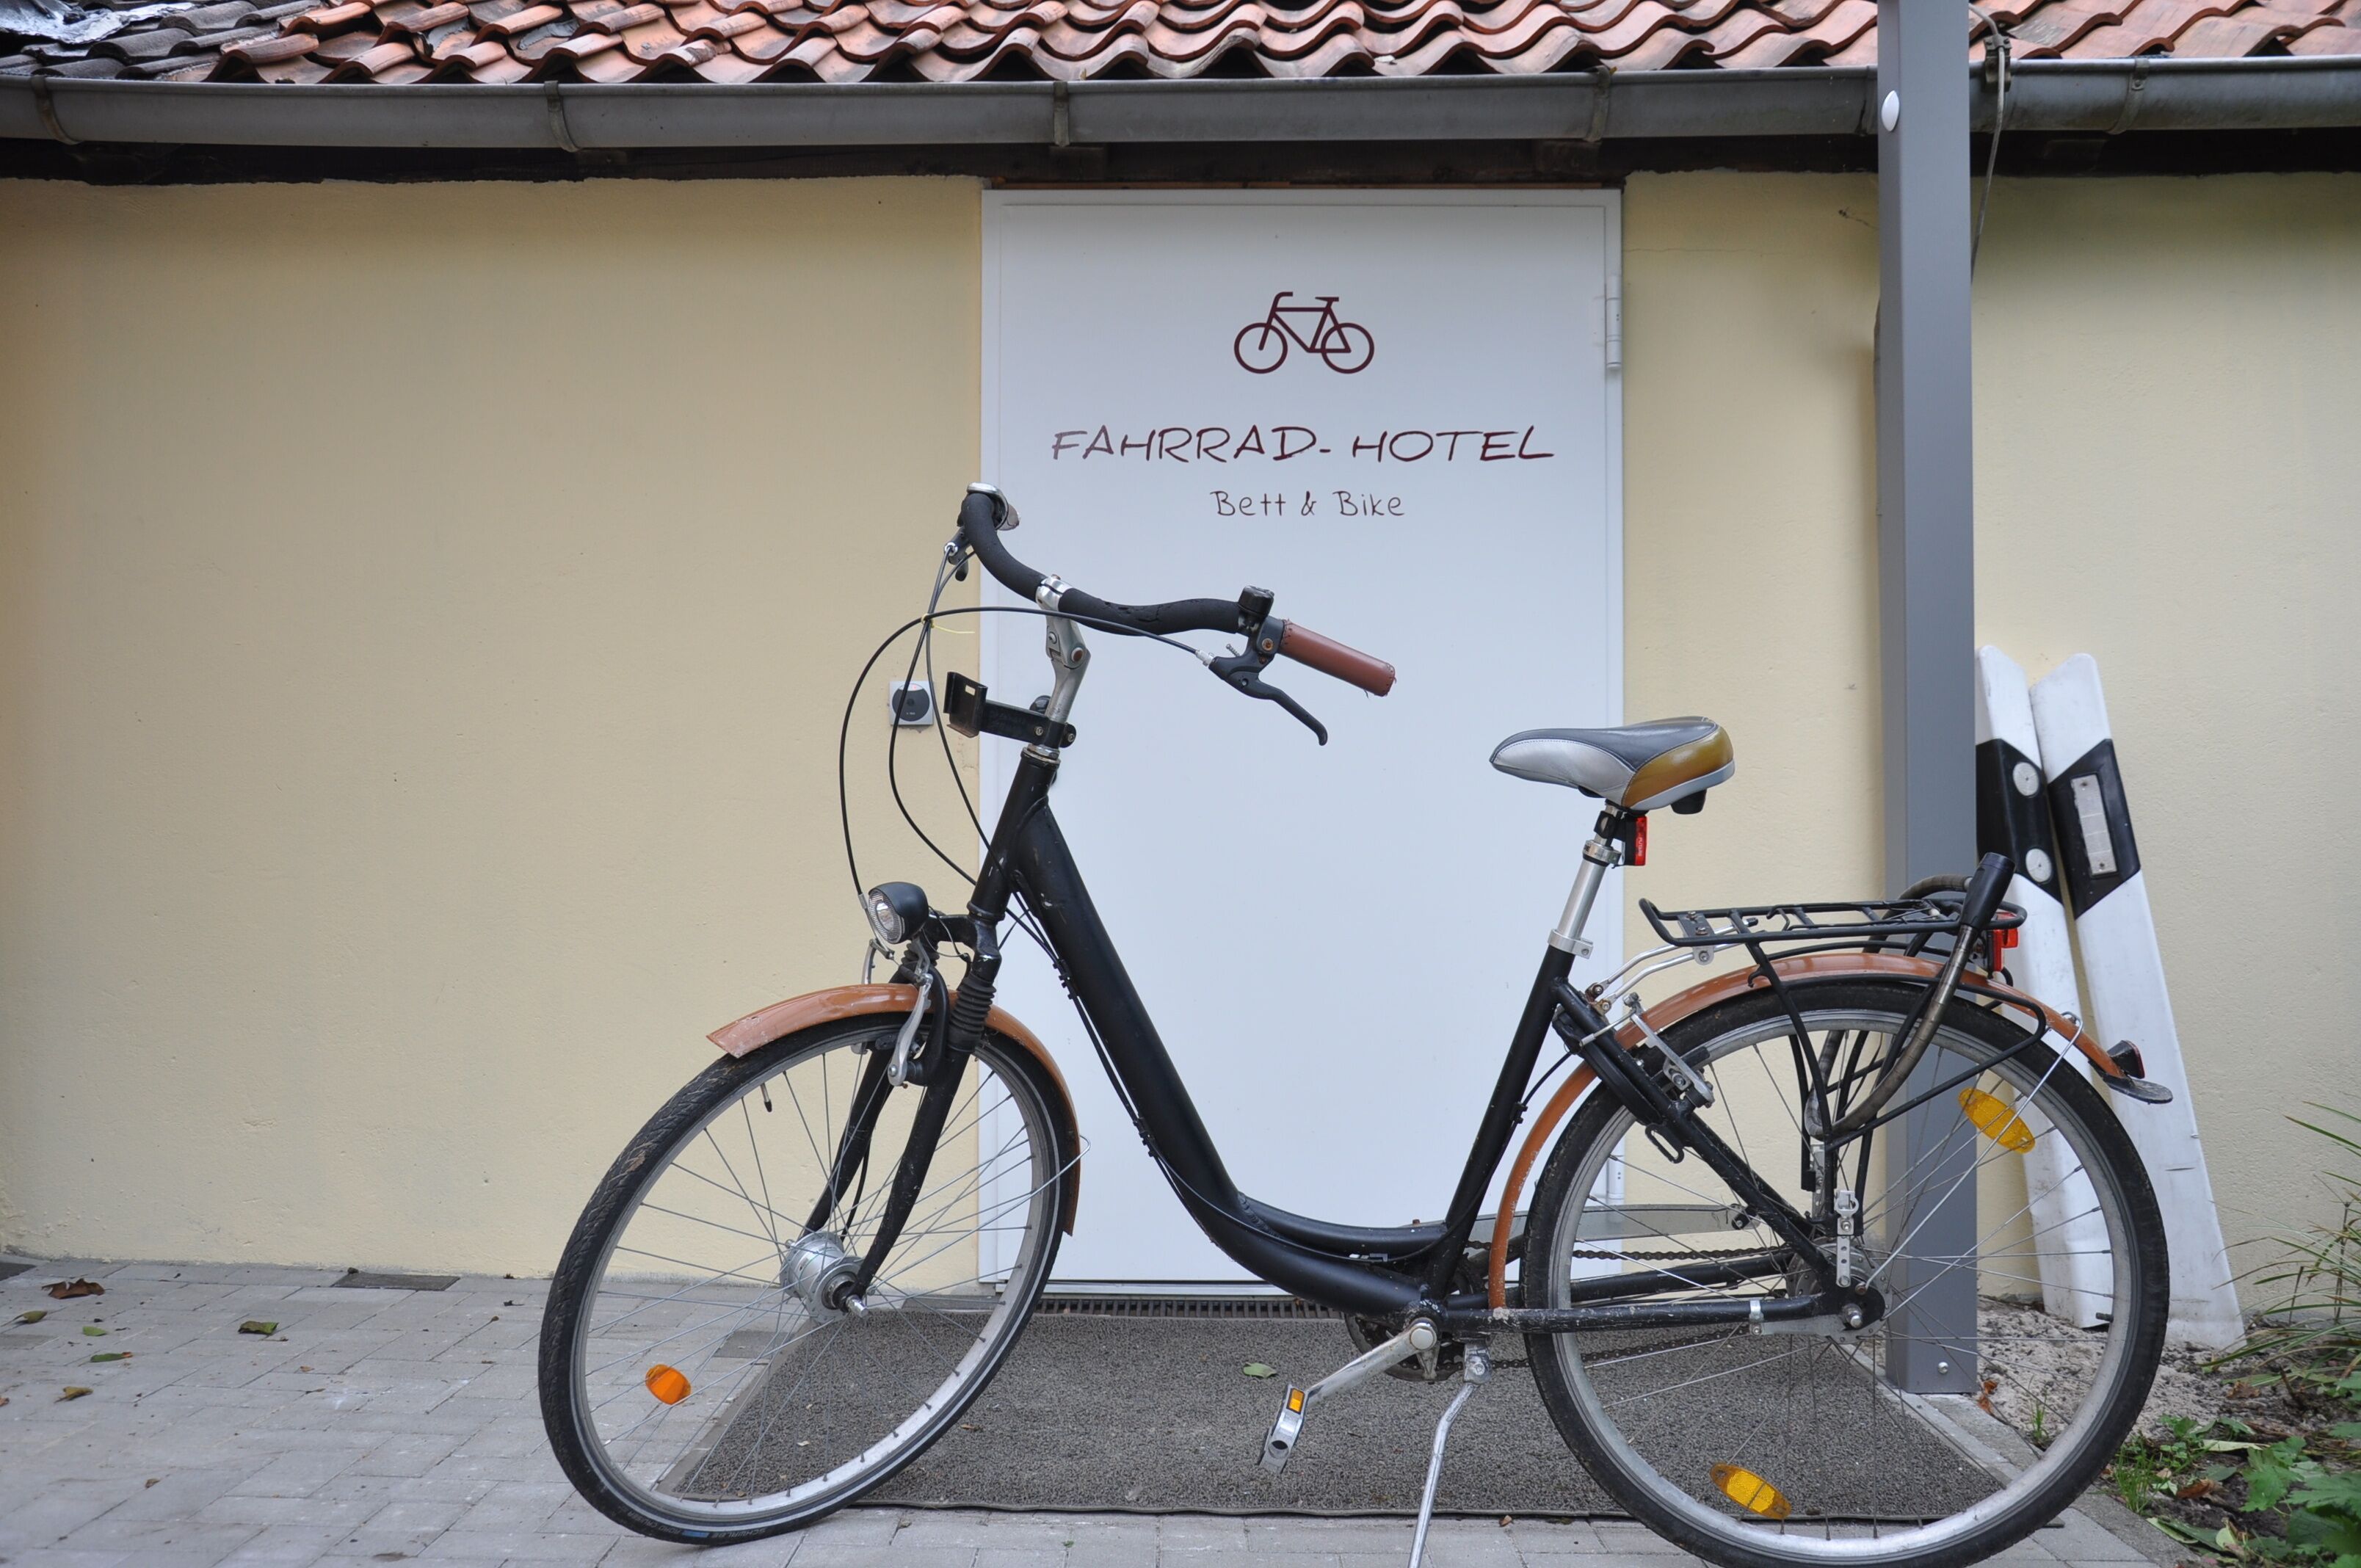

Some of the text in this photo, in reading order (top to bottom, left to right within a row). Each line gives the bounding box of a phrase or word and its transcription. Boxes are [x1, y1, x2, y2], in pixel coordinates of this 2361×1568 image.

[1352, 424, 1555, 462] HOTEL
[1209, 490, 1405, 517] Bett & Bike
